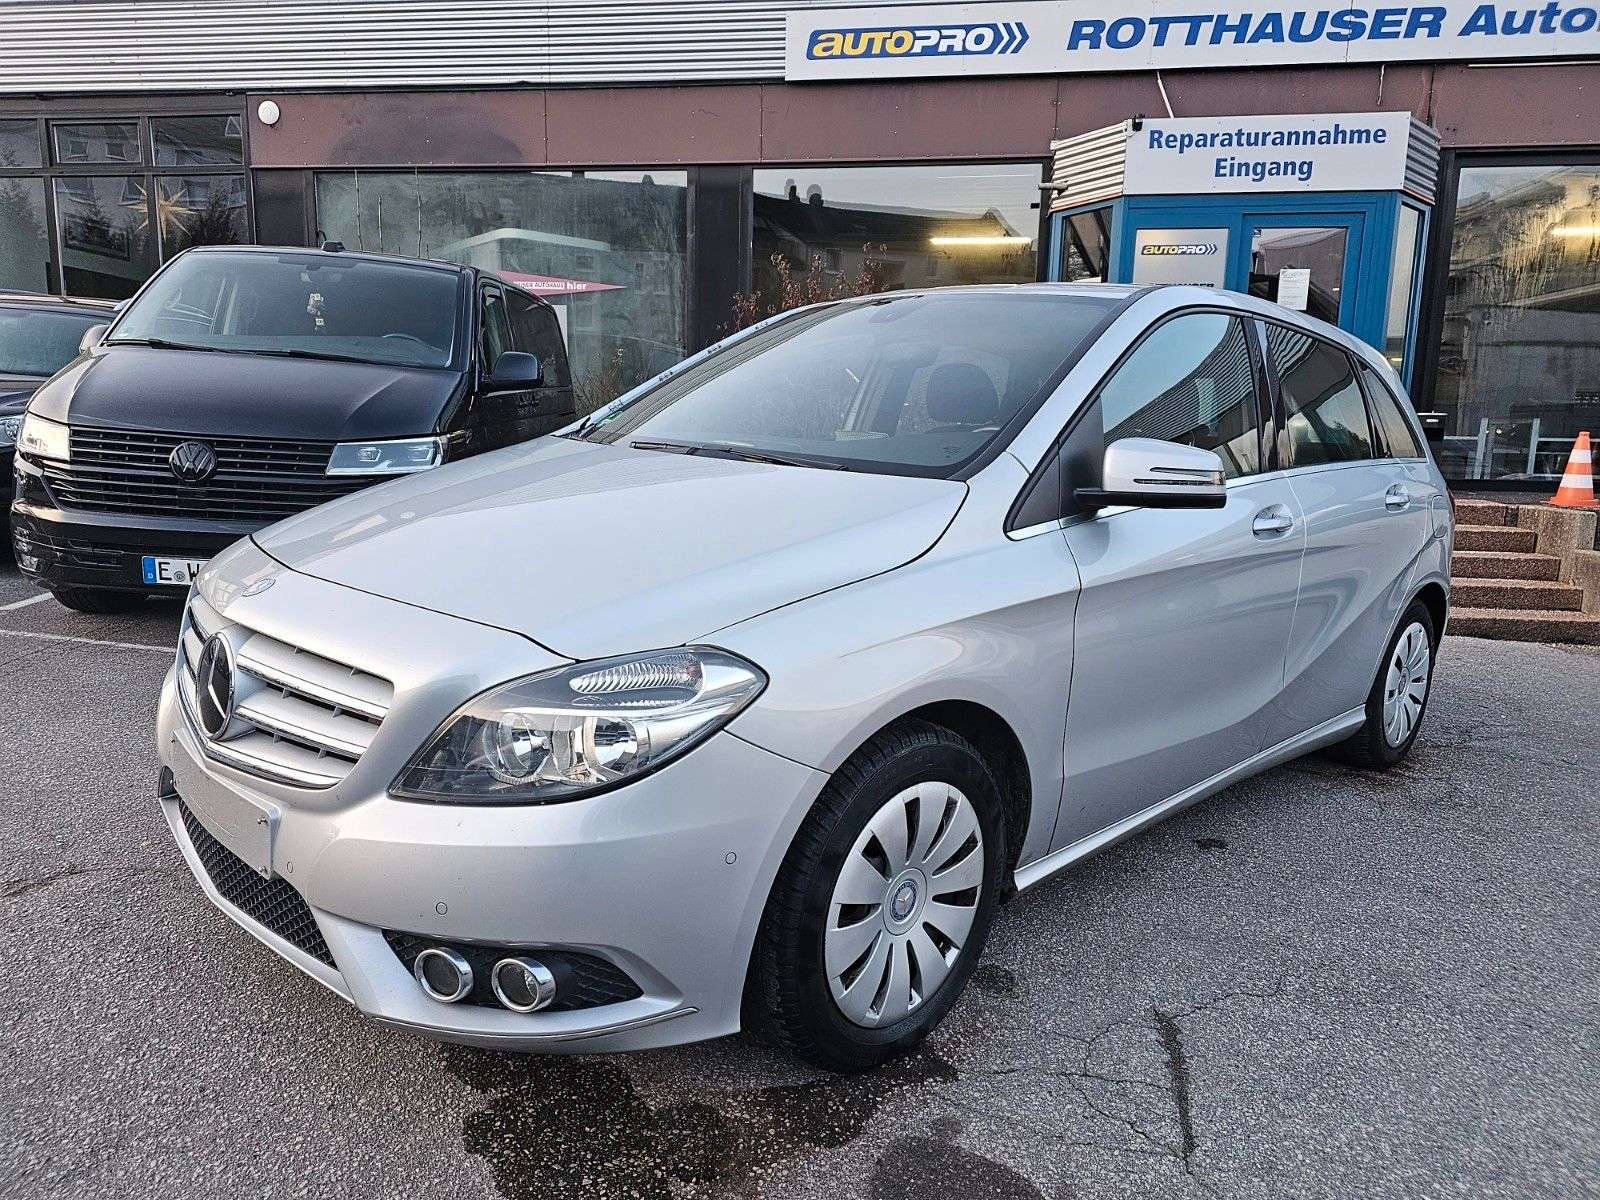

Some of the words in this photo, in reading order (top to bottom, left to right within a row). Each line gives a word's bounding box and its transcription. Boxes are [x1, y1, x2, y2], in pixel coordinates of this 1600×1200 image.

[1066, 6, 1446, 51] ROTTHAUSER
[1457, 2, 1600, 36] Auto
[1148, 124, 1387, 153] Reparaturannahme
[1214, 157, 1313, 182] Eingang
[158, 561, 172, 580] E
